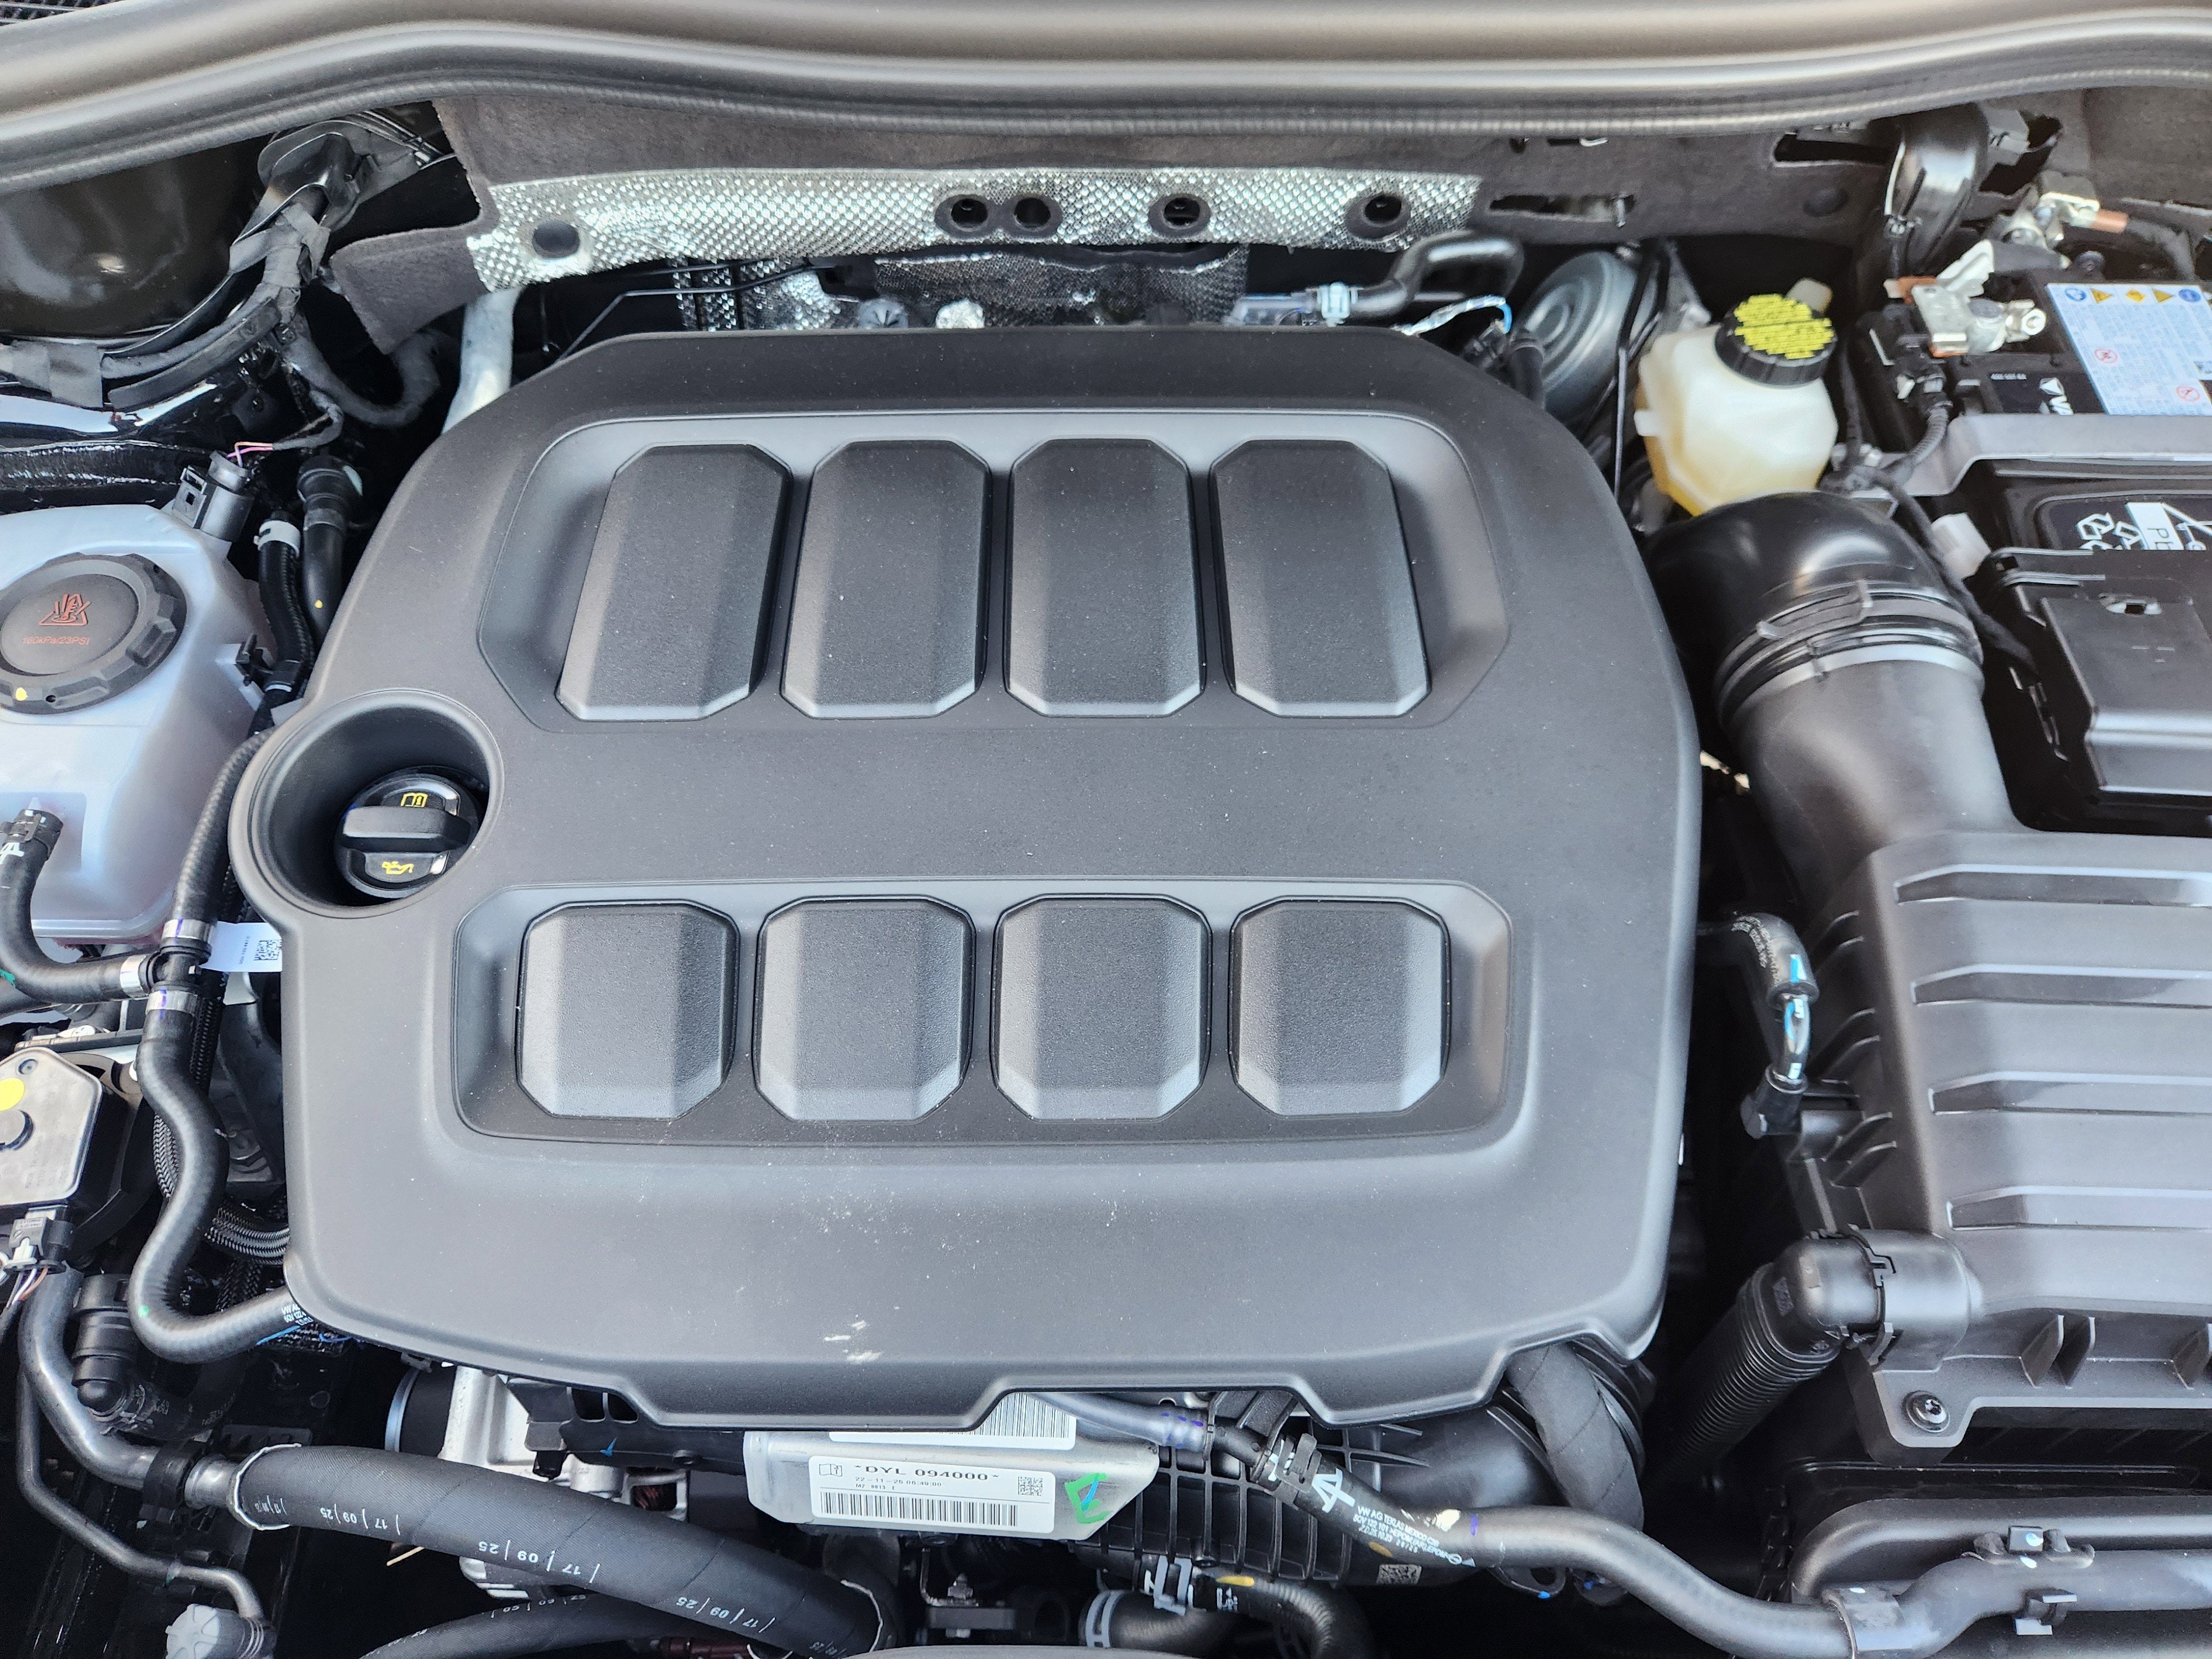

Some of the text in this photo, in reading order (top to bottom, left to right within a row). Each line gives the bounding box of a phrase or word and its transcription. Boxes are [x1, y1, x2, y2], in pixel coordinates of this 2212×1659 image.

[320, 1507, 388, 1530] 17 09 25
[1358, 1505, 1371, 1517] VW
[1370, 1509, 1383, 1521] AG
[478, 1541, 582, 1575] 17 09 25
[676, 1597, 759, 1628] 17 09 25
